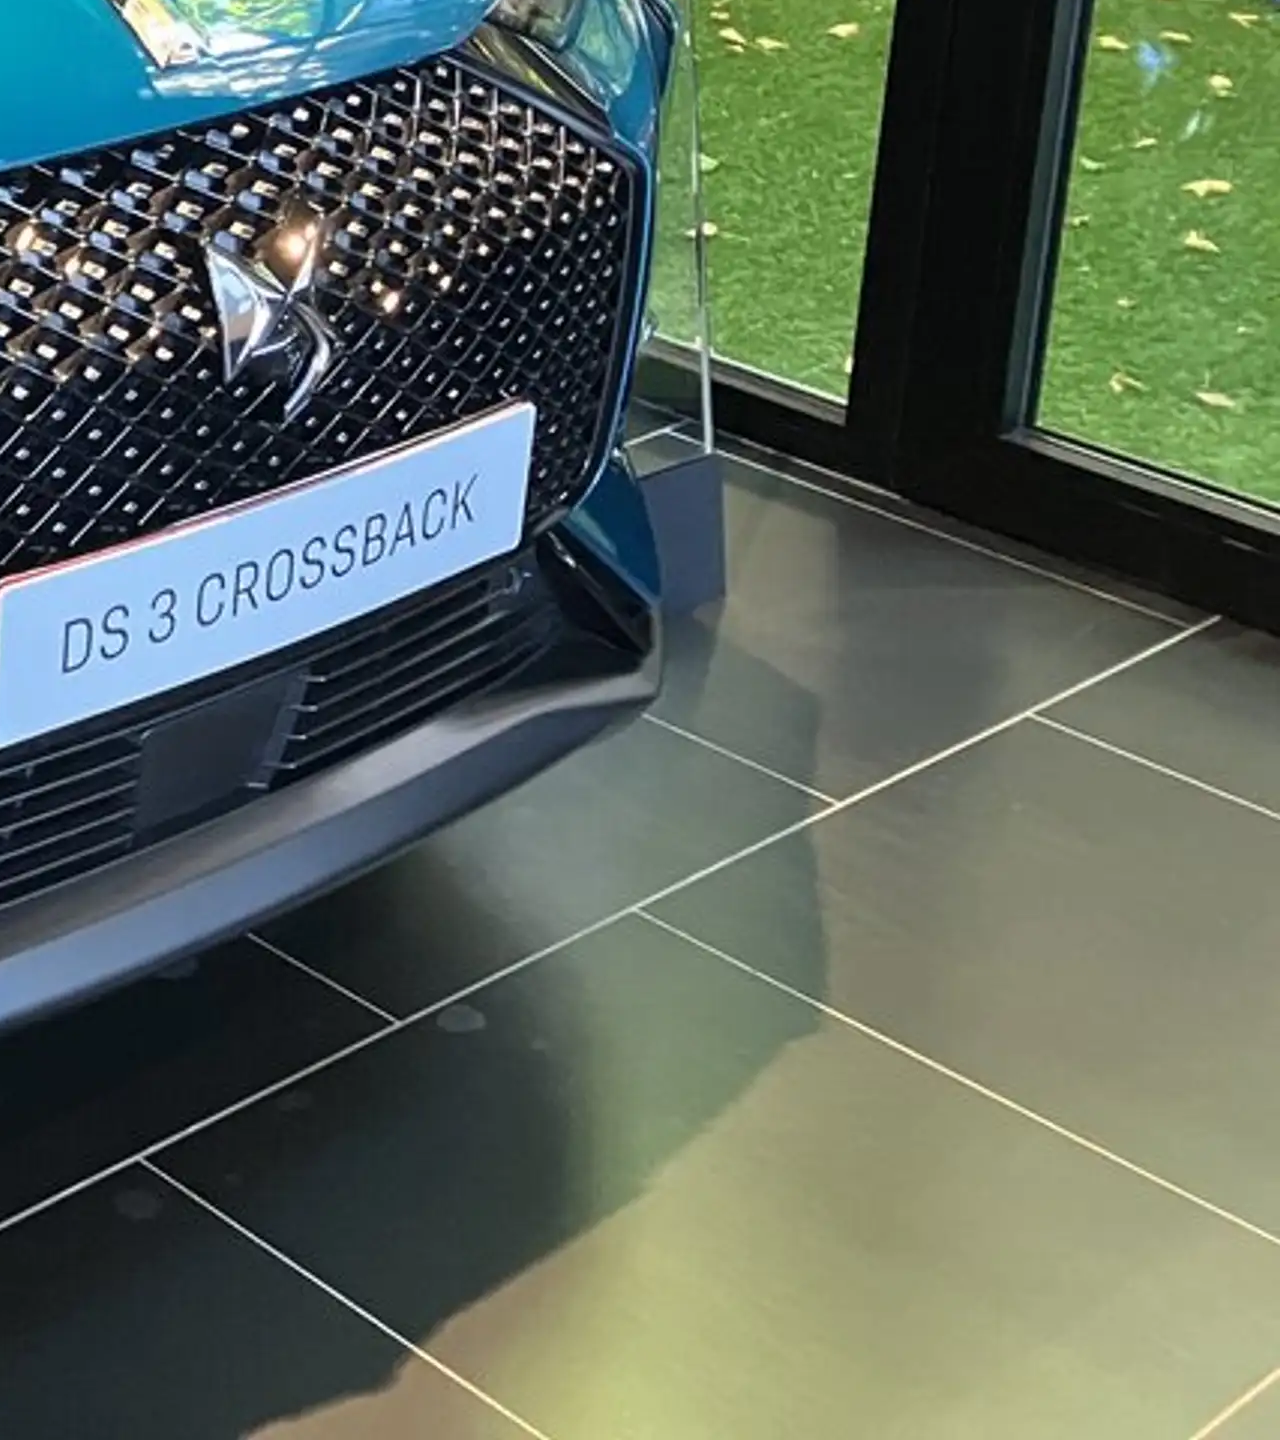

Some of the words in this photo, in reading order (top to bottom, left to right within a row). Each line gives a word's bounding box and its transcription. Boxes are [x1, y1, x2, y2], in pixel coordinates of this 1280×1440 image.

[61, 604, 130, 674] DS
[148, 588, 178, 644] 3
[196, 473, 479, 627] CROSSBACK
